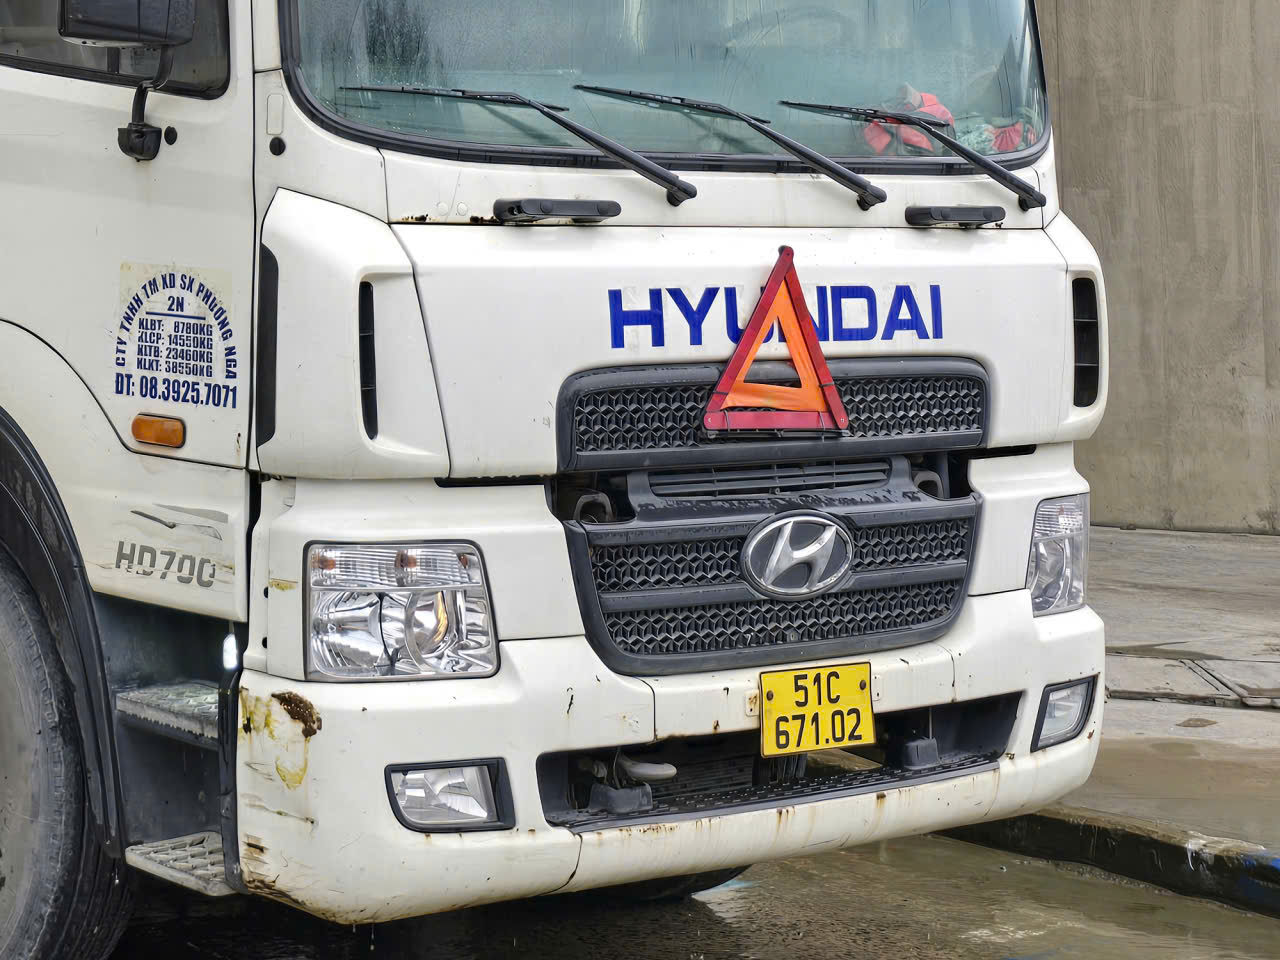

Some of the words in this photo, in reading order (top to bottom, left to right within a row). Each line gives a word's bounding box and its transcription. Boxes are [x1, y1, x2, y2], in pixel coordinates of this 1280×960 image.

[141, 277, 159, 299] TM
[180, 273, 195, 293] SX
[120, 293, 143, 333] TNHH
[167, 295, 185, 312] 2N
[138, 317, 164, 332] KLBT:
[174, 321, 213, 336] 8780KG
[115, 336, 127, 367] CTY
[138, 331, 165, 345] KLCP:
[167, 334, 213, 350] 14550KG
[136, 357, 162, 372] KLKT:
[165, 347, 213, 363] 23460KG
[224, 345, 237, 379] NGA
[139, 375, 237, 409] 08.3925.7071
[793, 671, 840, 708] 51C
[775, 707, 863, 749] 671.02
